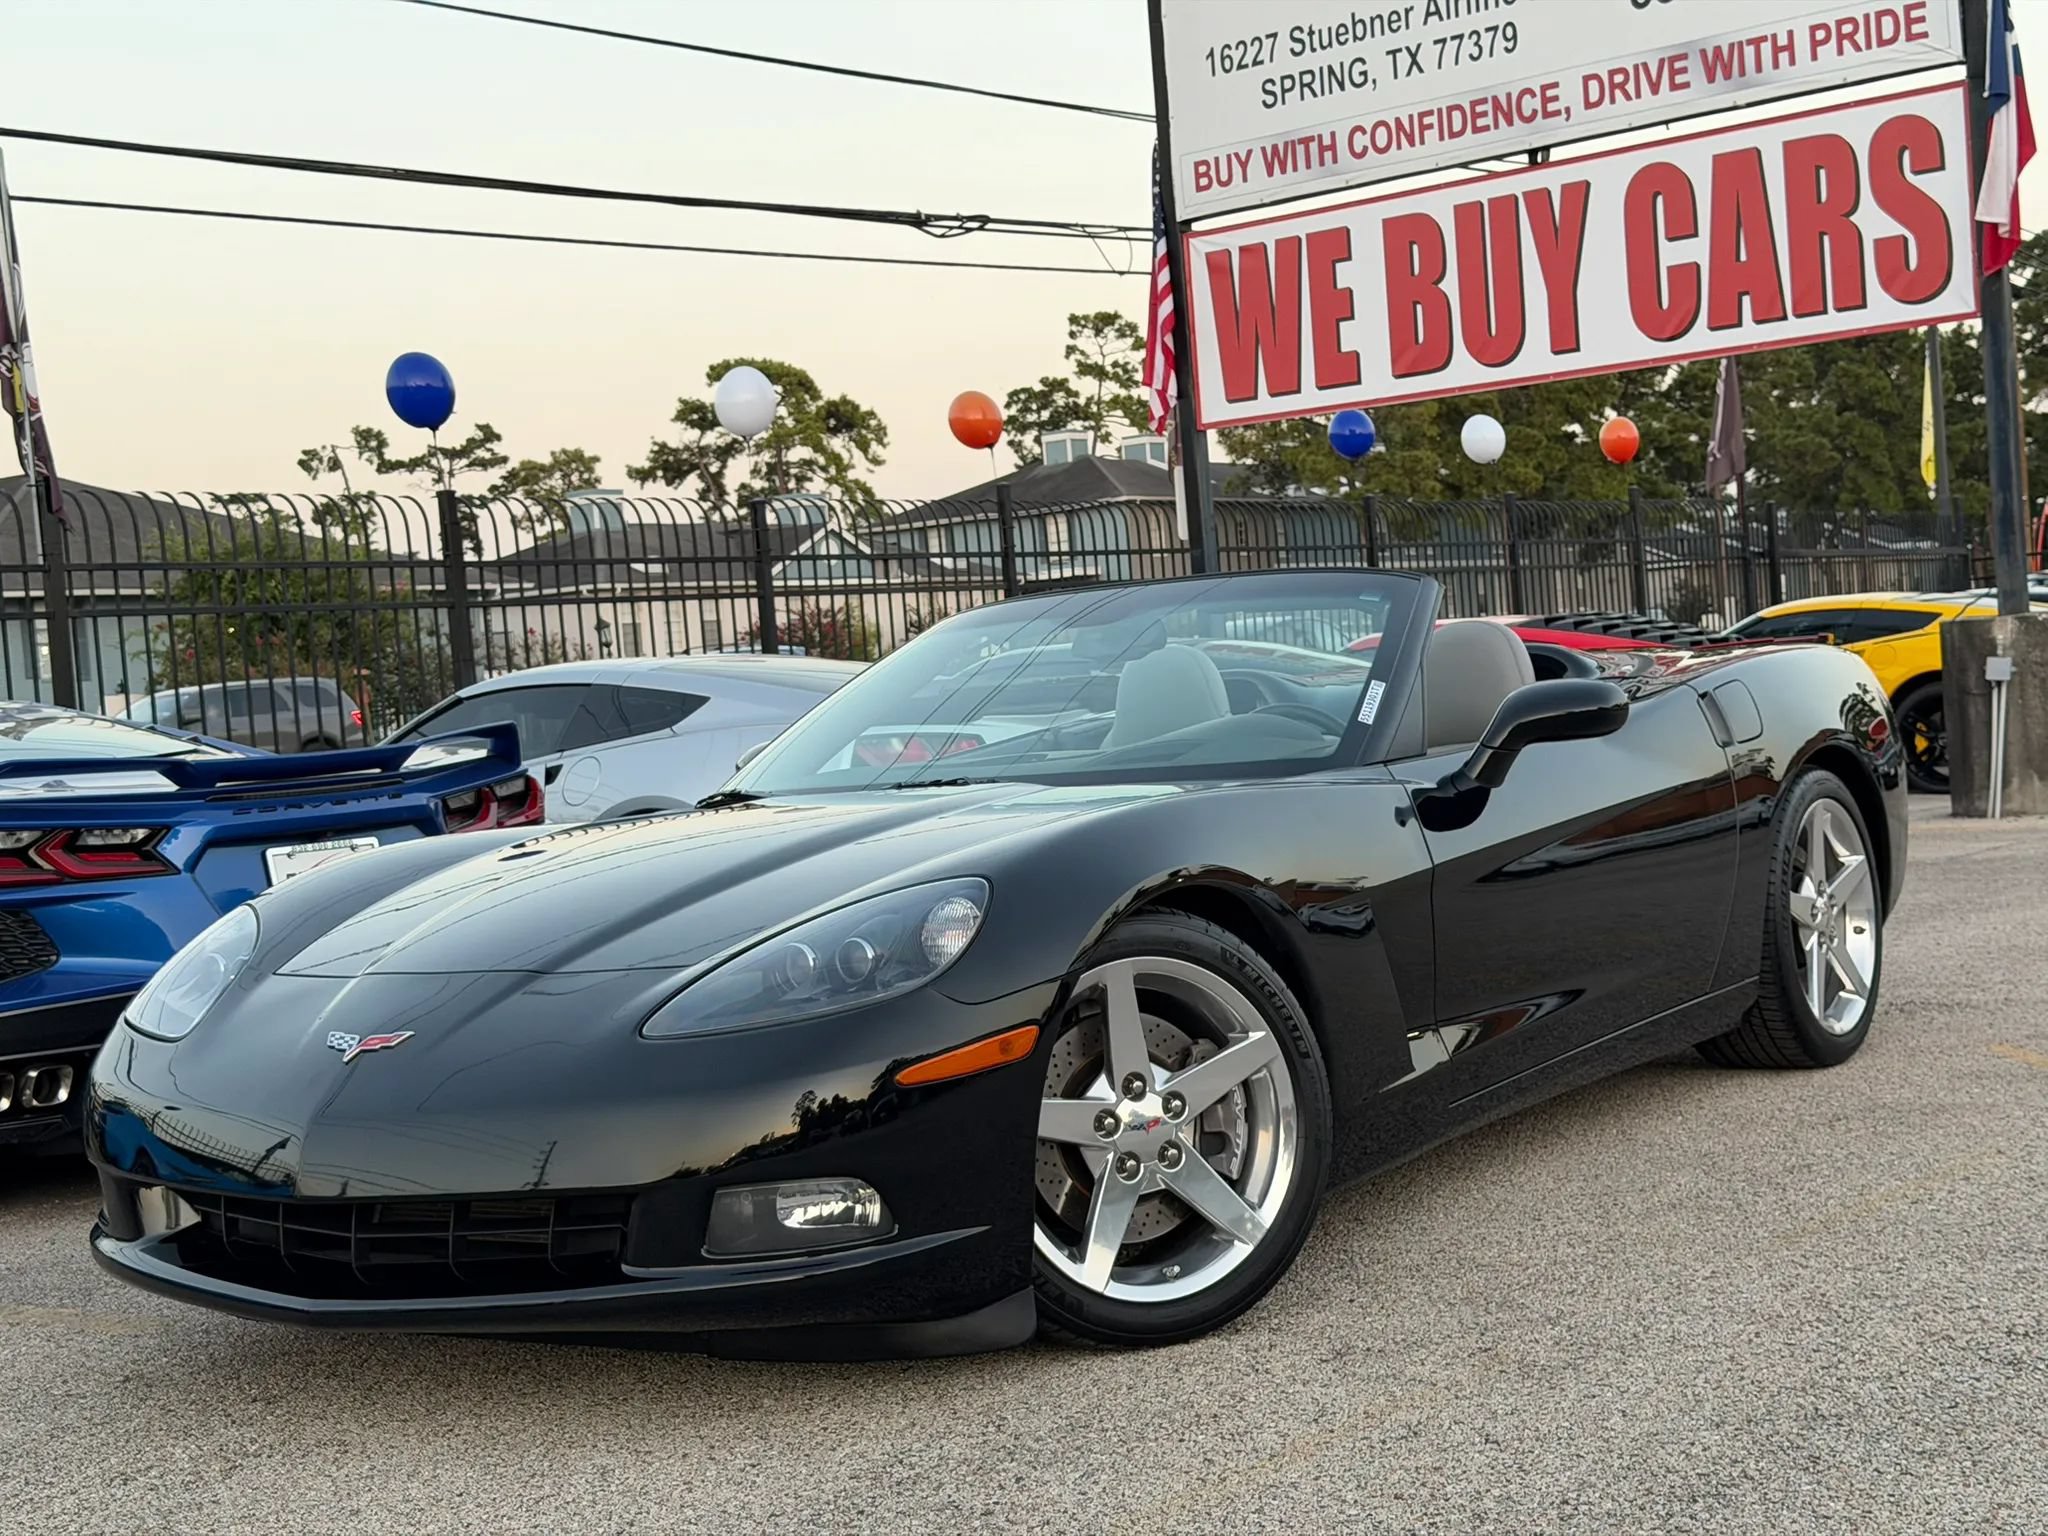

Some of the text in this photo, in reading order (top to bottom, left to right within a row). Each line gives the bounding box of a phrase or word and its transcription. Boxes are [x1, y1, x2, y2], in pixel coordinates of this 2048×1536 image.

[1205, 31, 1279, 77] 16227
[1289, 5, 1413, 58] Stuebner
[1260, 21, 1519, 110] SPRING, TX 77379
[1193, 1, 1929, 193] BUY WITH CONFIDENCE, DRIVE WITH PRIDE
[1204, 113, 1954, 404] WE BUY CARS
[1242, 964, 1310, 1058] MICHELIN
